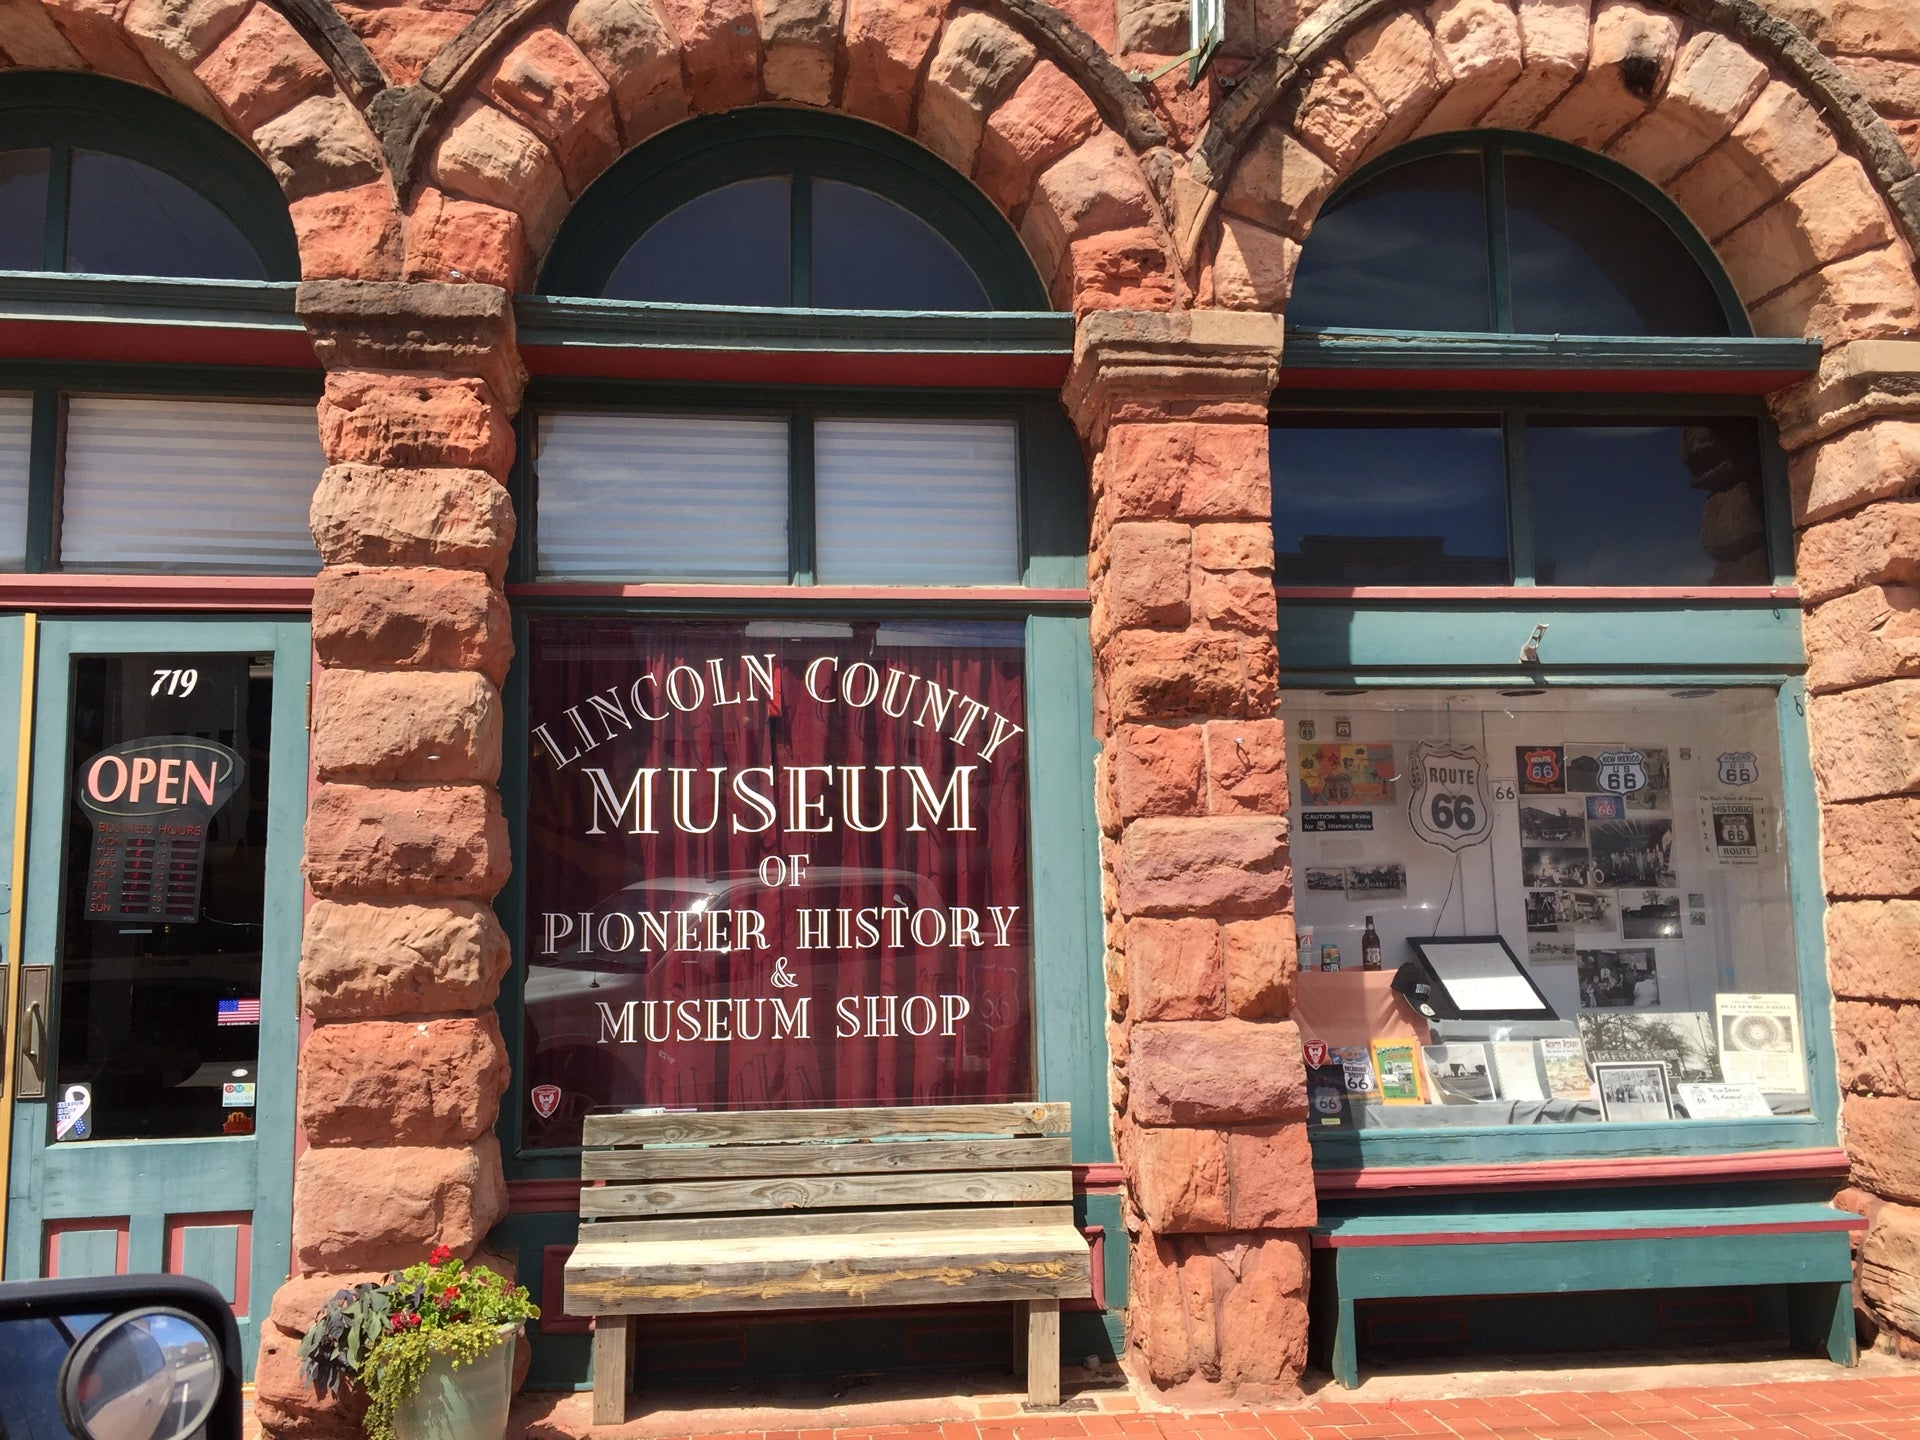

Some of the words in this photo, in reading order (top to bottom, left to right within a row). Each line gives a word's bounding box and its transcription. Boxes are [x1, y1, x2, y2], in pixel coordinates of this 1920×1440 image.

[150, 668, 198, 698] 719
[531, 654, 777, 771] LINCOLN
[805, 656, 1024, 763] COUNTY
[1429, 767, 1474, 785] ROUTE
[1533, 765, 1553, 779] 66
[1726, 769, 1750, 782] 66
[87, 755, 217, 806] OPEN
[1608, 773, 1636, 790] 66
[582, 765, 978, 835] MUSEUM
[1496, 787, 1516, 800] 66
[1431, 793, 1476, 830] 66
[1599, 804, 1614, 816] 66
[1713, 805, 1752, 813] HISTORIC
[98, 821, 153, 835] BUSINESS
[158, 824, 203, 837] HOURS
[1727, 830, 1744, 841] 66
[1723, 847, 1752, 855] ROUTE
[758, 854, 810, 887] OF
[89, 903, 112, 913] SUN
[542, 910, 771, 954] PIONEER
[797, 906, 1020, 949] HISTORY
[770, 956, 798, 989] &
[595, 997, 811, 1044] MUSEUM
[836, 994, 971, 1038] SHOP
[1347, 1078, 1369, 1090] 66
[57, 1101, 84, 1109] FREEDOM
[1320, 1096, 1337, 1109] 66
